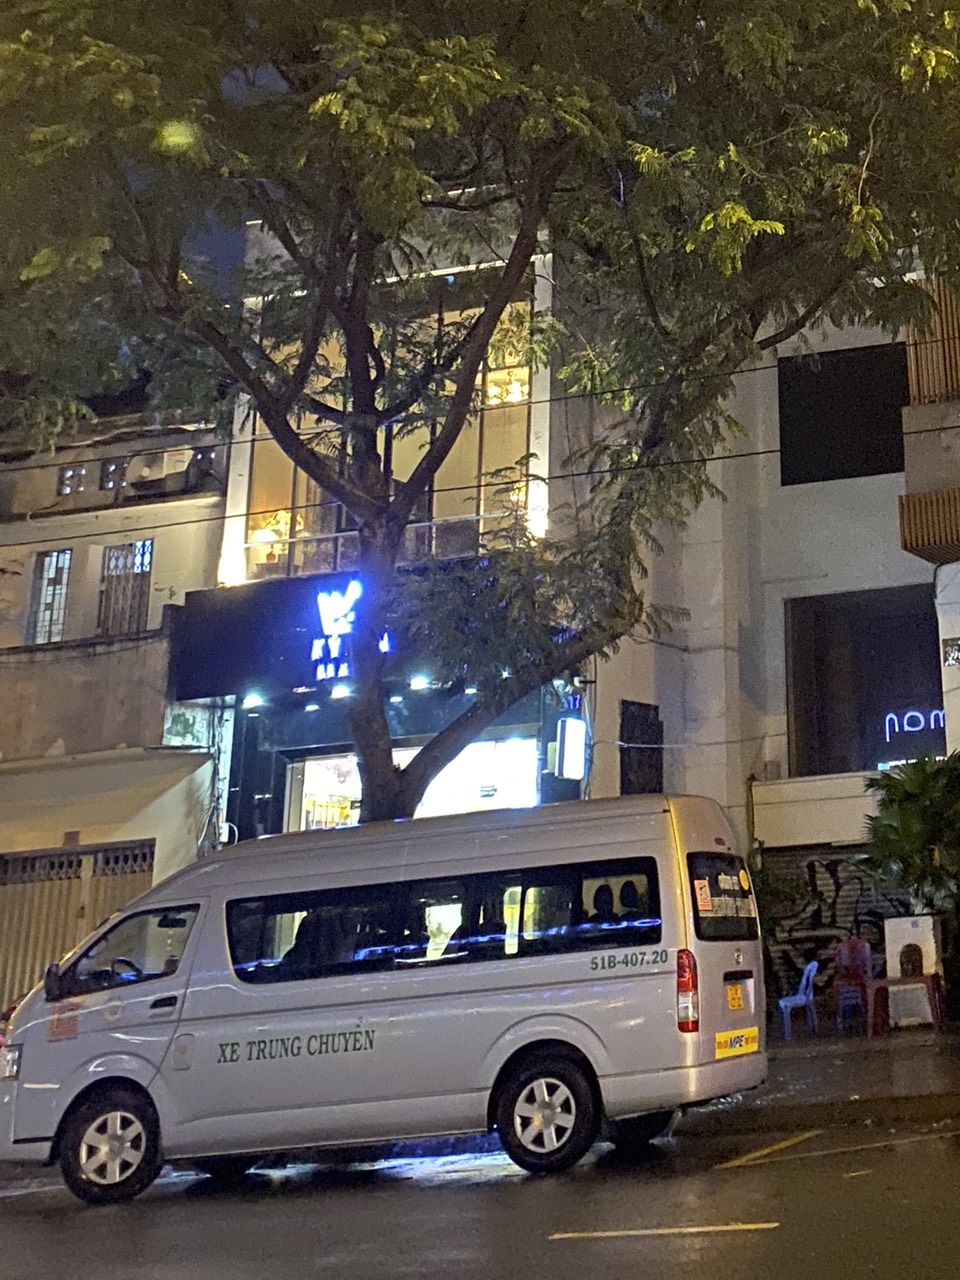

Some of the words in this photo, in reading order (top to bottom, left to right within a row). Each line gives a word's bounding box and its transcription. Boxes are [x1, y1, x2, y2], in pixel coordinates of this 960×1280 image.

[590, 950, 668, 971] 51B-407.20
[217, 1042, 240, 1064] XE
[246, 1035, 302, 1061] TRUNG
[306, 1016, 375, 1056] CHUYỂN
